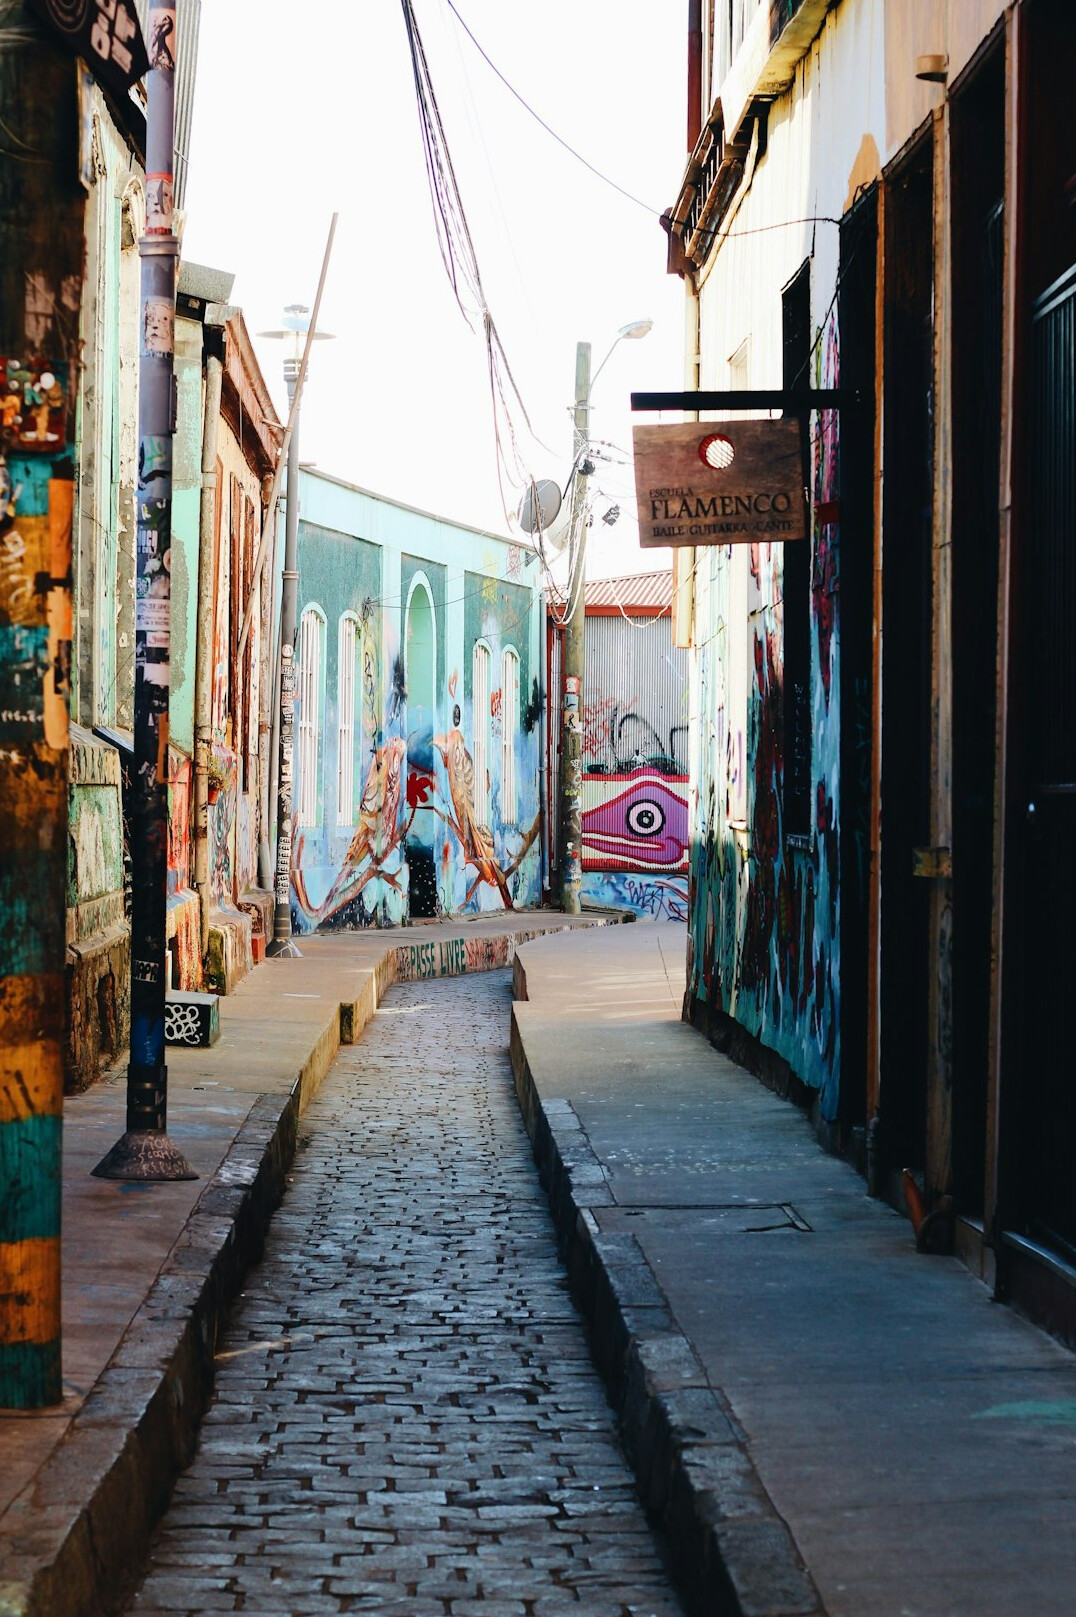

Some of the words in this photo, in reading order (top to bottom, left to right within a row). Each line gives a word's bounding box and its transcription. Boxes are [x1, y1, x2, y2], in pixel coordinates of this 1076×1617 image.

[649, 487, 694, 498] ESCUELA
[651, 492, 791, 520] FLAMENCO
[653, 525, 685, 537] BAILE
[689, 521, 749, 536] GUITARRA
[755, 520, 794, 532] CANTE
[410, 942, 436, 978] PASSE
